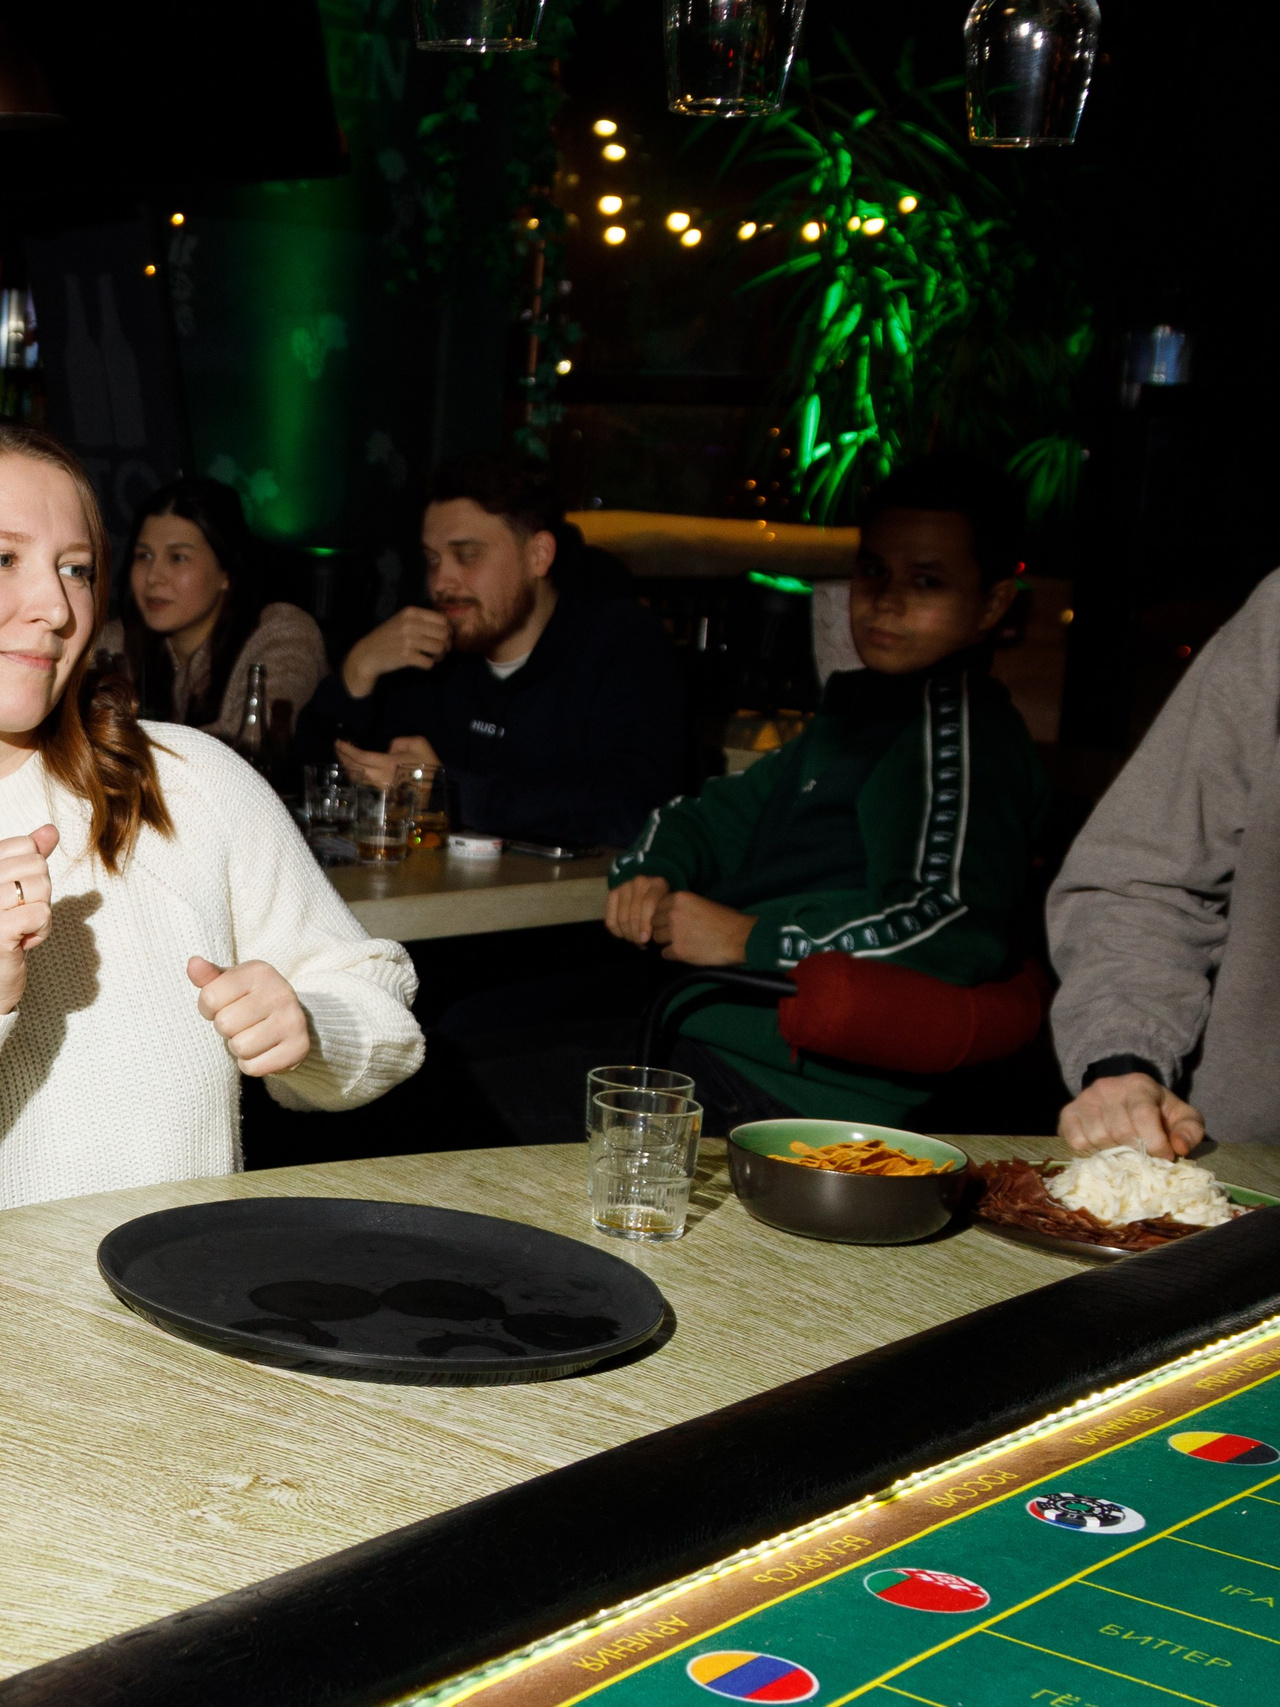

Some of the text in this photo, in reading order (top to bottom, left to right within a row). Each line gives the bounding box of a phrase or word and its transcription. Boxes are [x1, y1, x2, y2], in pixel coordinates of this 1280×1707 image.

[1069, 1405, 1166, 1446] ГЕРМАНИЯ
[925, 1469, 1019, 1508] РОССИЯ
[753, 1534, 873, 1583] БЕЛАРУСЬ
[572, 1614, 689, 1672] АРМЕНИЯ
[1098, 1623, 1233, 1668] БИТТЕР
